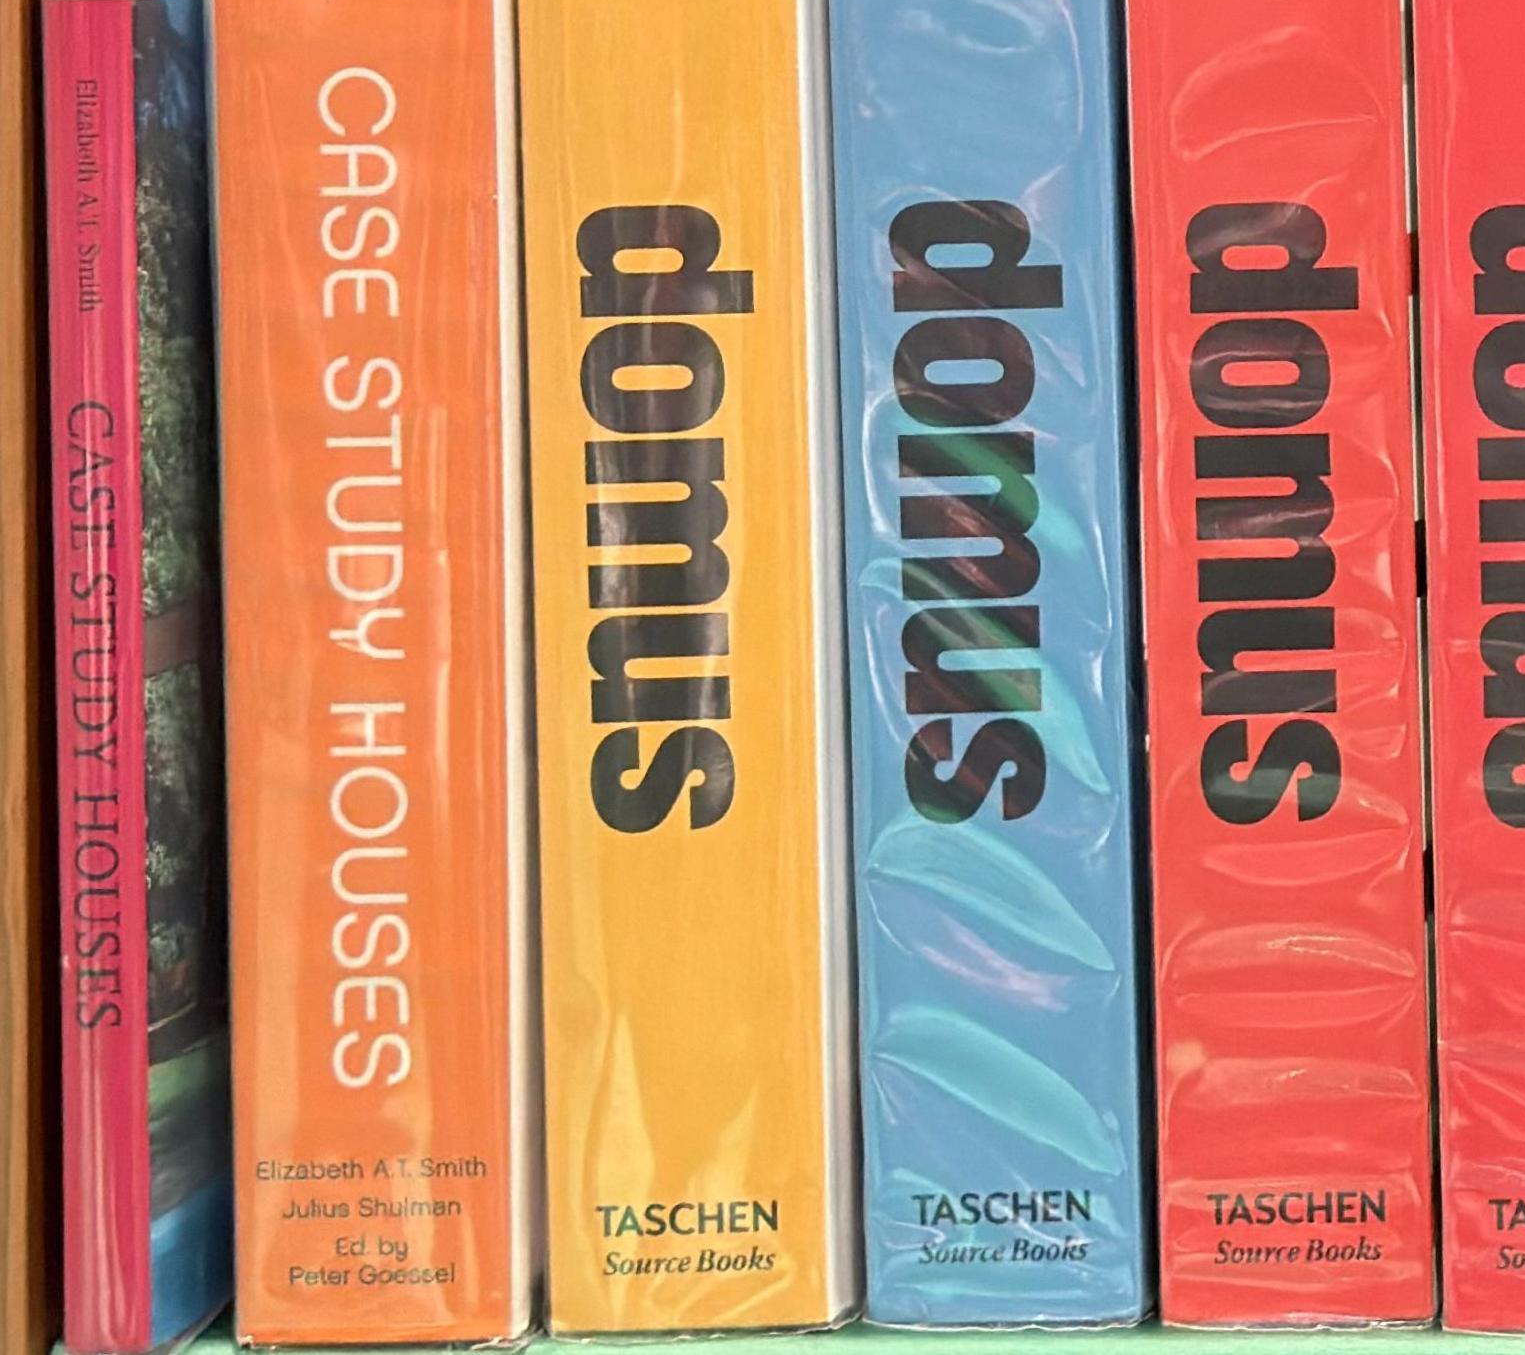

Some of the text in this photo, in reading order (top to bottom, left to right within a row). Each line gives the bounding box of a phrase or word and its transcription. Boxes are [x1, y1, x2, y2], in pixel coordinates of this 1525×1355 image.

[76, 78, 100, 184] Elizabeth
[78, 244, 103, 313] Smith
[575, 203, 755, 834] domus
[887, 199, 1064, 826] domus
[1185, 201, 1360, 827] domus
[317, 66, 412, 1089] CASE STUDY HOUSES
[67, 400, 122, 1030] CASE STUDY HOUSES
[255, 1160, 365, 1181] Elizabeth
[420, 1156, 487, 1178] Smith
[281, 1196, 462, 1220] Julius Shulman
[595, 1199, 779, 1239] TASCHEN
[910, 1189, 1093, 1227] TASCHEN
[1207, 1188, 1386, 1227] TASCHEN
[378, 1235, 409, 1262] by
[603, 1247, 775, 1277] Source Books
[918, 1236, 1089, 1266] Source Books
[1213, 1238, 1383, 1266] Source Books
[288, 1262, 456, 1286] Peter Goessel
